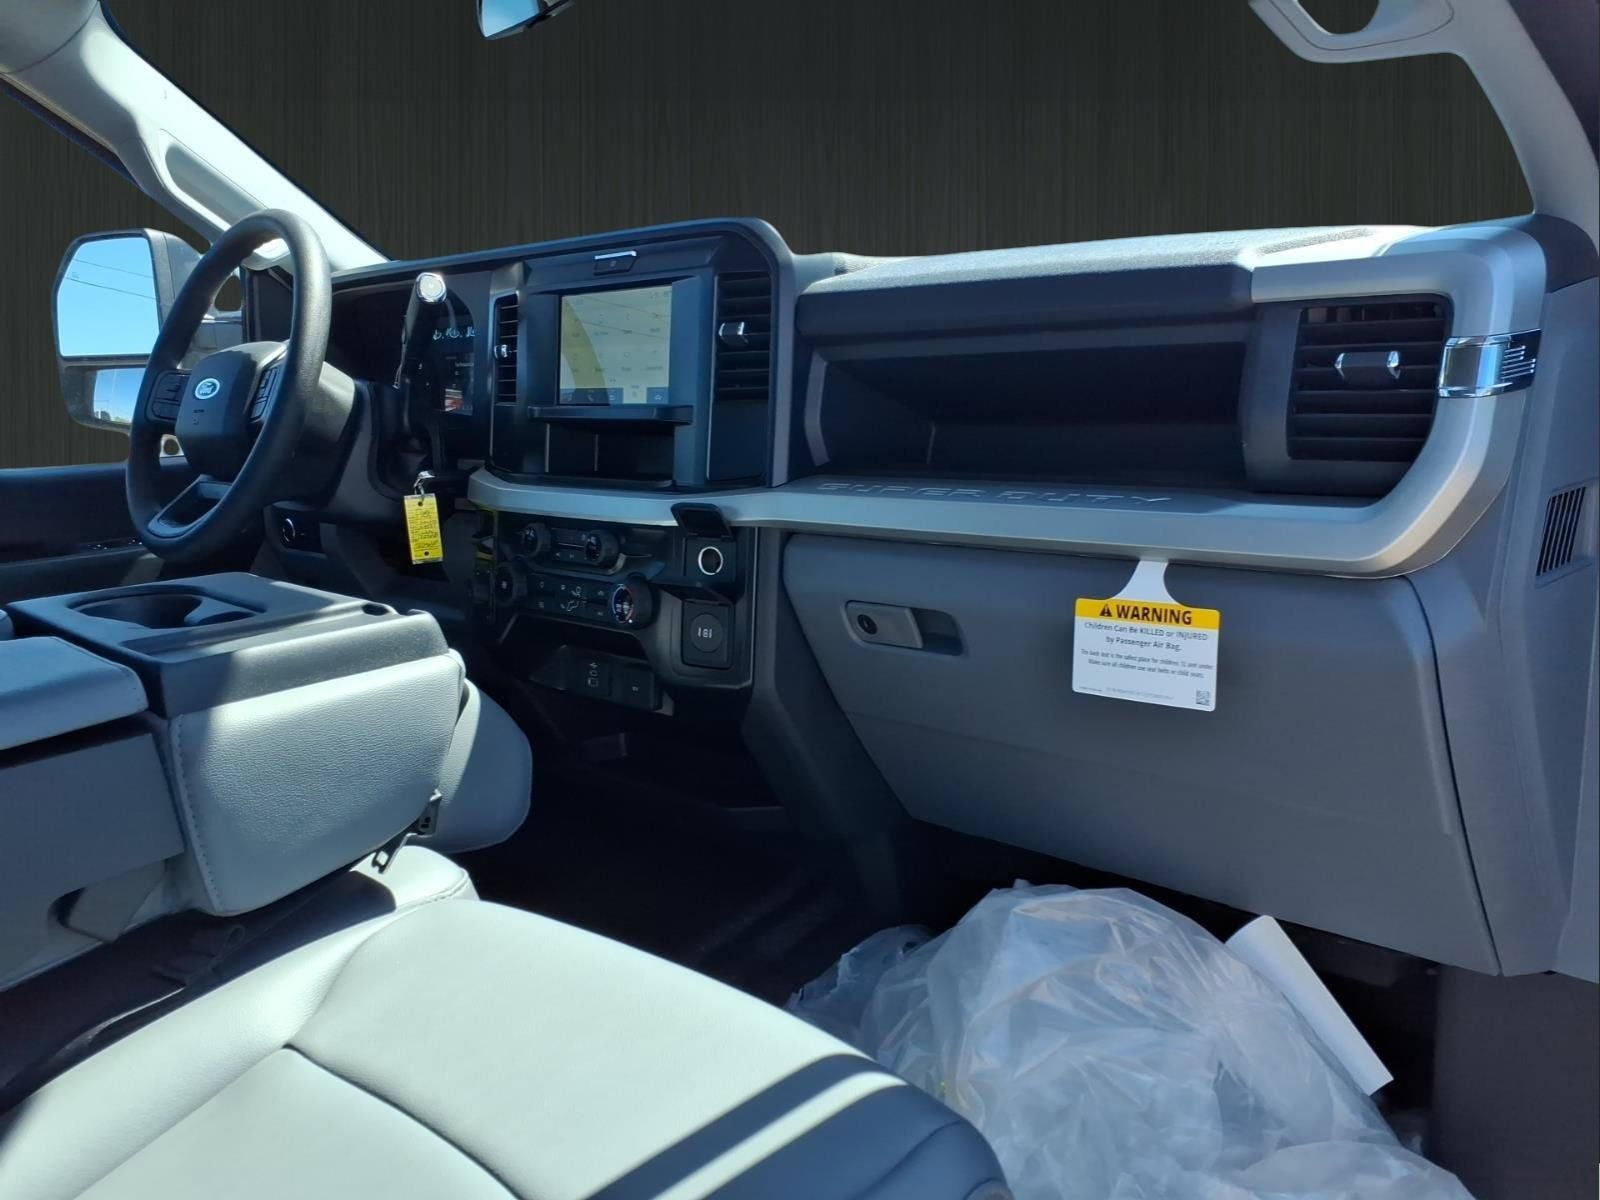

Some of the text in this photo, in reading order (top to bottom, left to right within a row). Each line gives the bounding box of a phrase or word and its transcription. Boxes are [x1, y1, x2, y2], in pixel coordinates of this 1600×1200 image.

[816, 483, 1172, 505] SUPER DUTY
[1116, 604, 1193, 625] WARNING
[1084, 622, 1113, 631] Children
[1114, 624, 1128, 632] Can
[1129, 626, 1138, 634] Be
[1140, 628, 1165, 637] KILLED
[1176, 631, 1209, 641] INJURED
[1106, 636, 1114, 645] by
[1116, 636, 1152, 649] Passenger
[1153, 641, 1164, 649] Air
